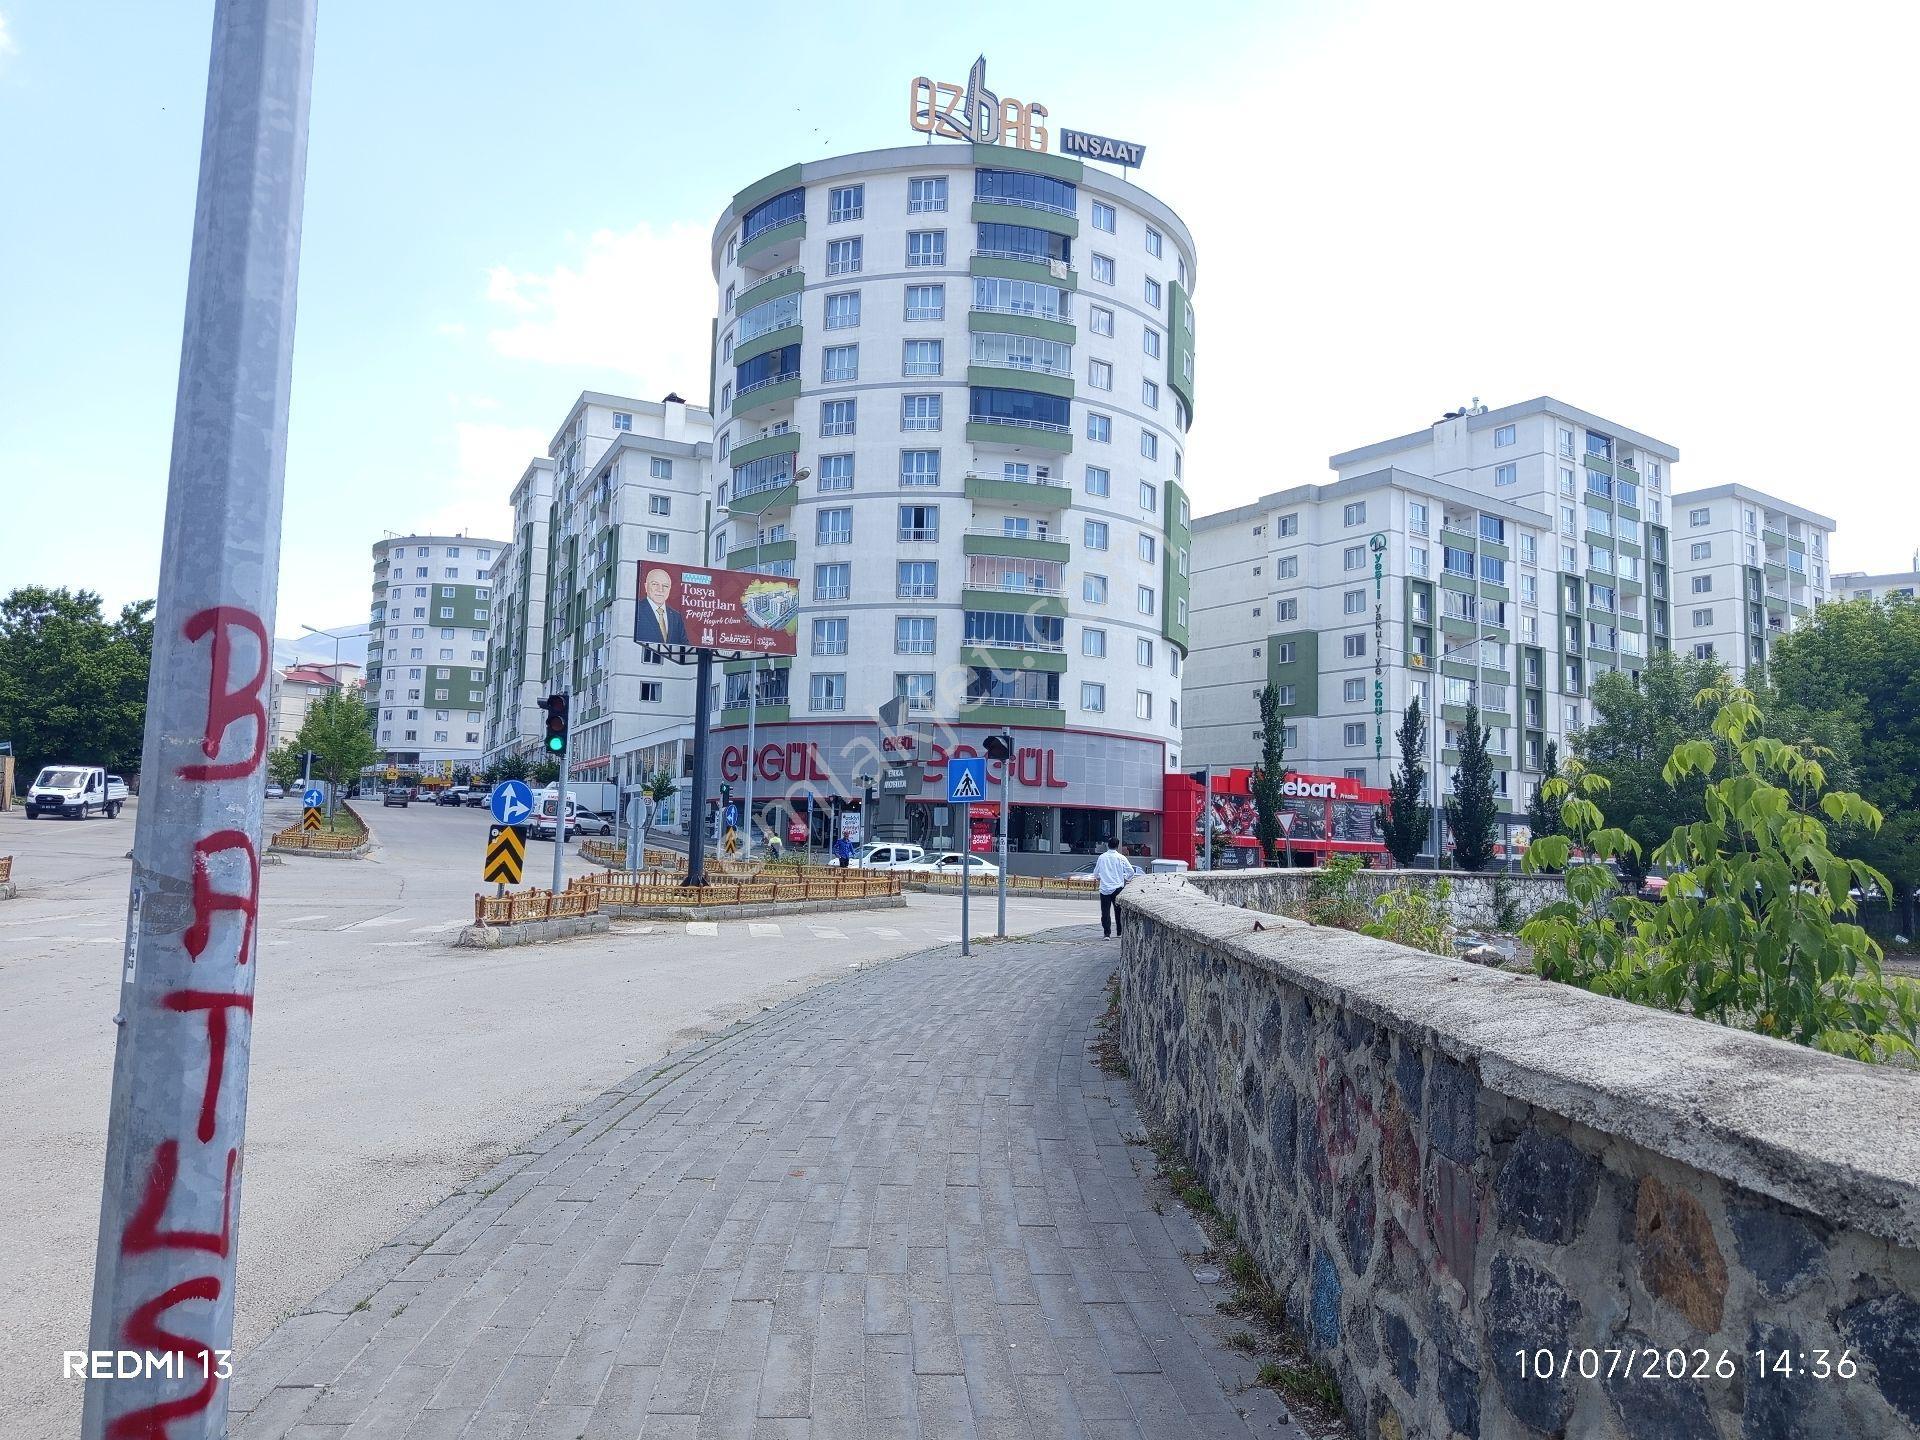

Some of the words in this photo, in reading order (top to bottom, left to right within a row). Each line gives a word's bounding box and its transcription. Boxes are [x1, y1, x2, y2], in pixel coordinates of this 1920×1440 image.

[681, 583, 715, 600] Tosya
[681, 595, 736, 611] Konutları
[685, 609, 714, 621] Projesi
[719, 632, 752, 644] Sekmen
